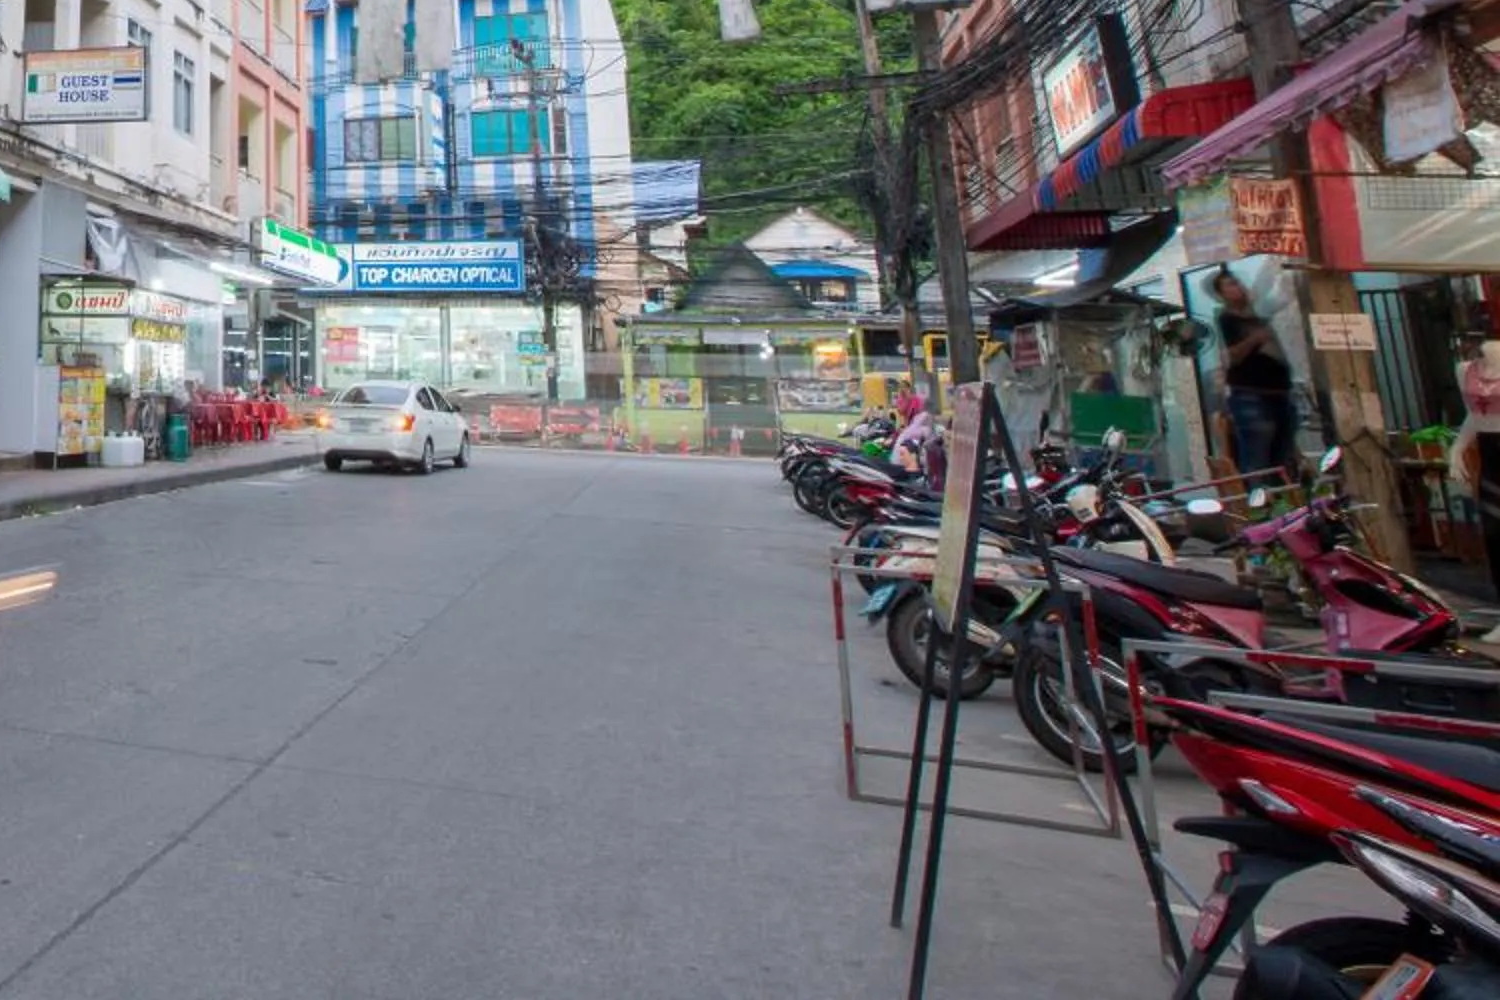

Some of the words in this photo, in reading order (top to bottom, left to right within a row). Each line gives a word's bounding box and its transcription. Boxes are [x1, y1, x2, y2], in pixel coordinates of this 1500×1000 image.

[61, 75, 108, 88] GUEST
[58, 89, 109, 102] HOUSE
[359, 267, 388, 284] TOP
[391, 267, 459, 284] CHAROEN
[460, 267, 514, 284] OPTICAL
